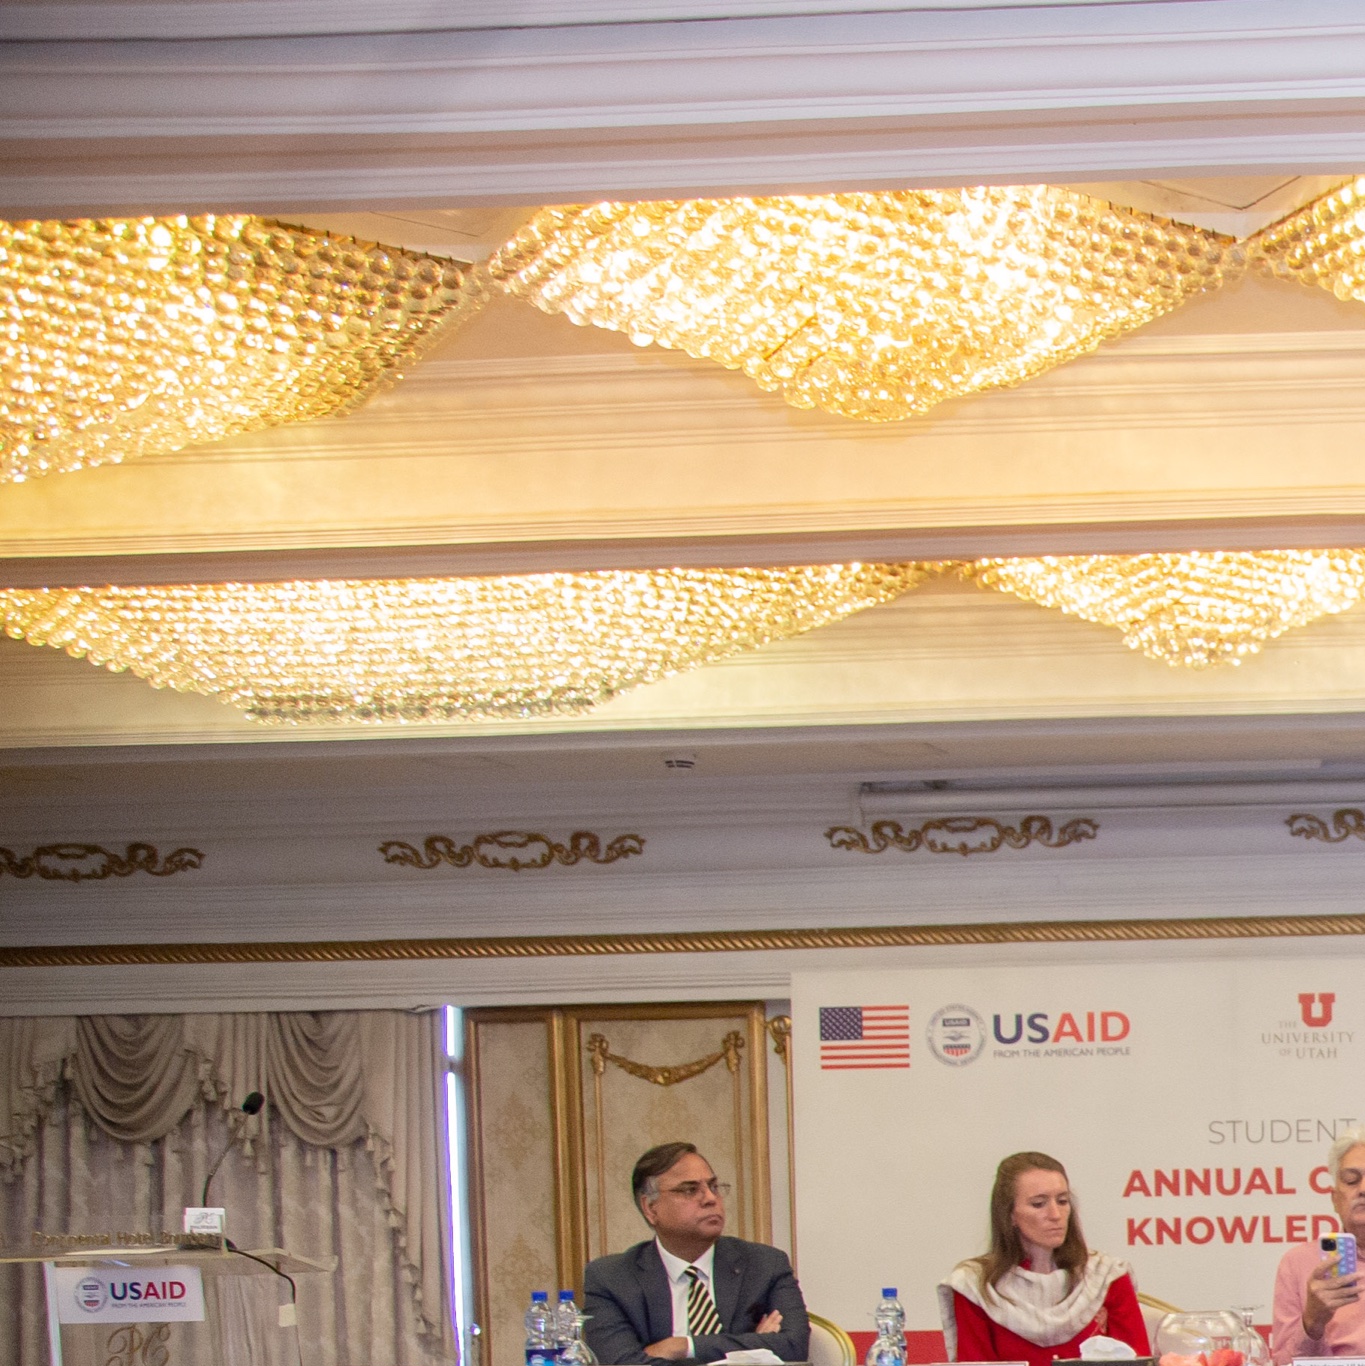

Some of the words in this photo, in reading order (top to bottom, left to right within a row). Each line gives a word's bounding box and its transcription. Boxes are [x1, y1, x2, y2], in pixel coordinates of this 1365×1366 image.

[1297, 992, 1336, 1028] U
[992, 1011, 1131, 1044] USAID
[1260, 1031, 1355, 1045] UNIVERSITY
[993, 1049, 1019, 1059] FROM
[1024, 1049, 1040, 1058] THE
[1044, 1048, 1092, 1058] AMERICAN
[1097, 1046, 1131, 1057] PEOPLE
[1295, 1047, 1338, 1059] UTAH
[1122, 1167, 1297, 1198] ANNUAL
[1126, 1214, 1341, 1246] KNOWLED
[110, 1281, 187, 1300] USAID
